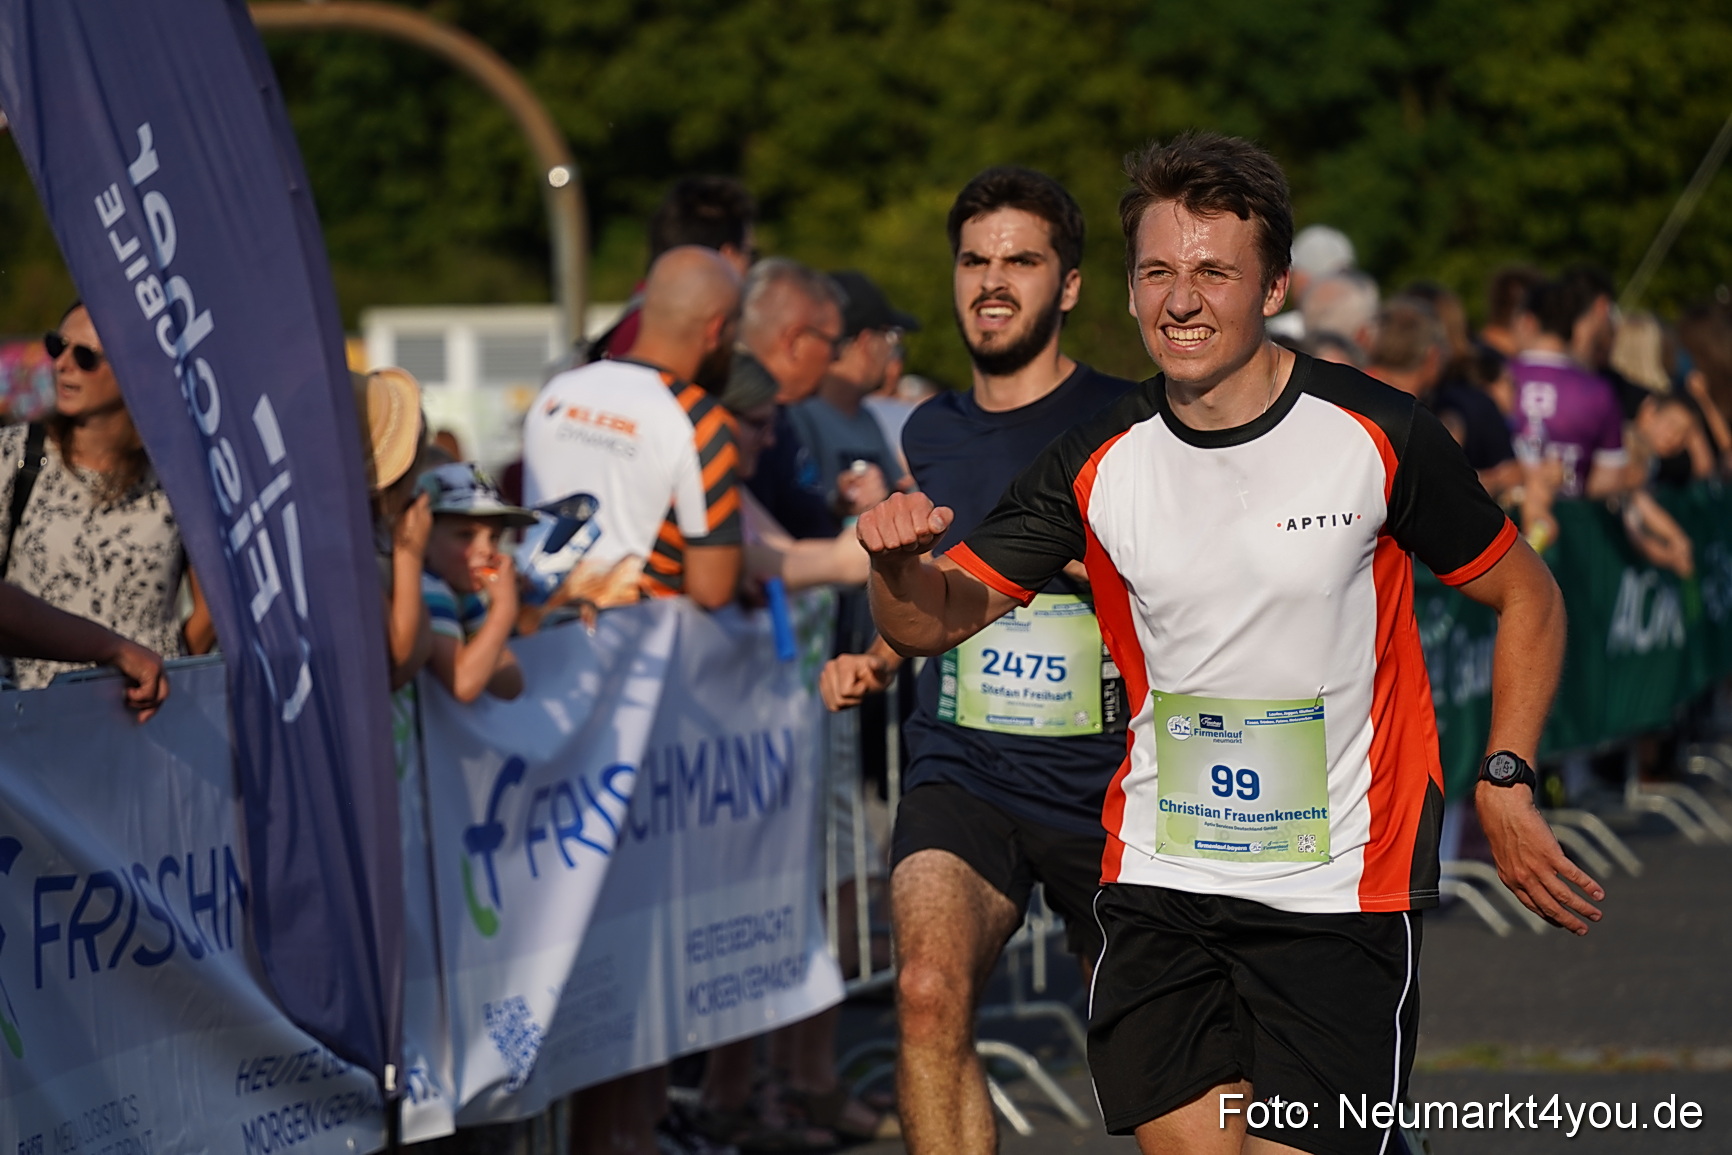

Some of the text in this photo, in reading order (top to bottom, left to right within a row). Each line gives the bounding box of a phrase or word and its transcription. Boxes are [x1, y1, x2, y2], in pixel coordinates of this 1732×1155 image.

[1286, 512, 1353, 531] APTIV
[982, 648, 1067, 682] 2475
[981, 683, 1073, 701] Stefan Freihart
[1194, 728, 1242, 738] Firmenlauf
[1211, 764, 1261, 801] 99
[1159, 798, 1328, 823] Christian Frauenknecht
[235, 1046, 319, 1098] HEUTE
